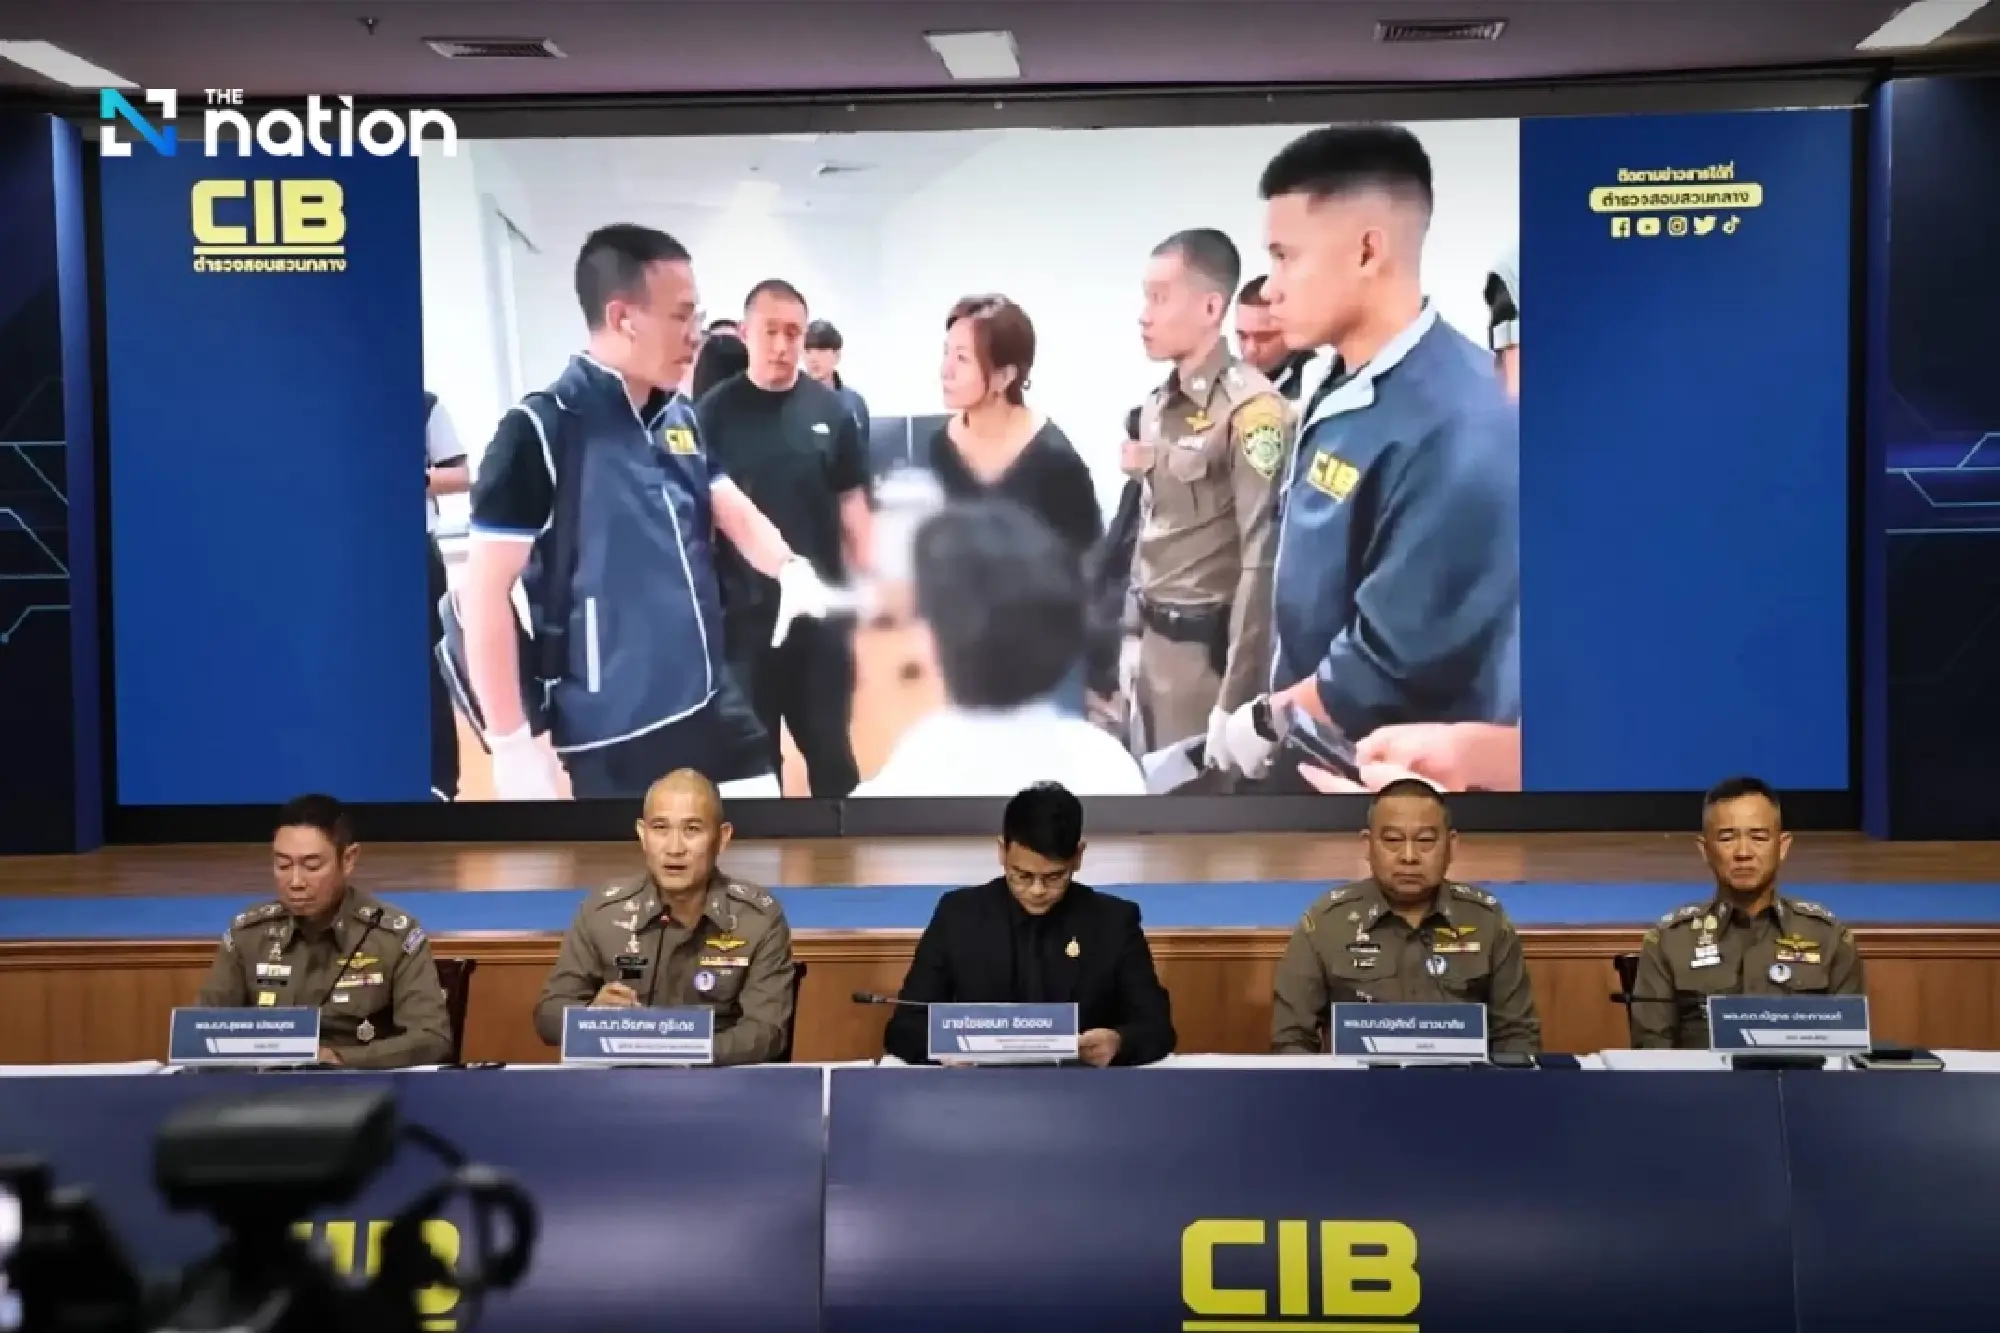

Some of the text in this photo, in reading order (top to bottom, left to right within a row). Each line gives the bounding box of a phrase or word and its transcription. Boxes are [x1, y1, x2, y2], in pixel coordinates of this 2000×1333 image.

[191, 179, 346, 244] CIB
[1308, 450, 1361, 498] CIB
[1181, 1218, 1421, 1316] CIB
